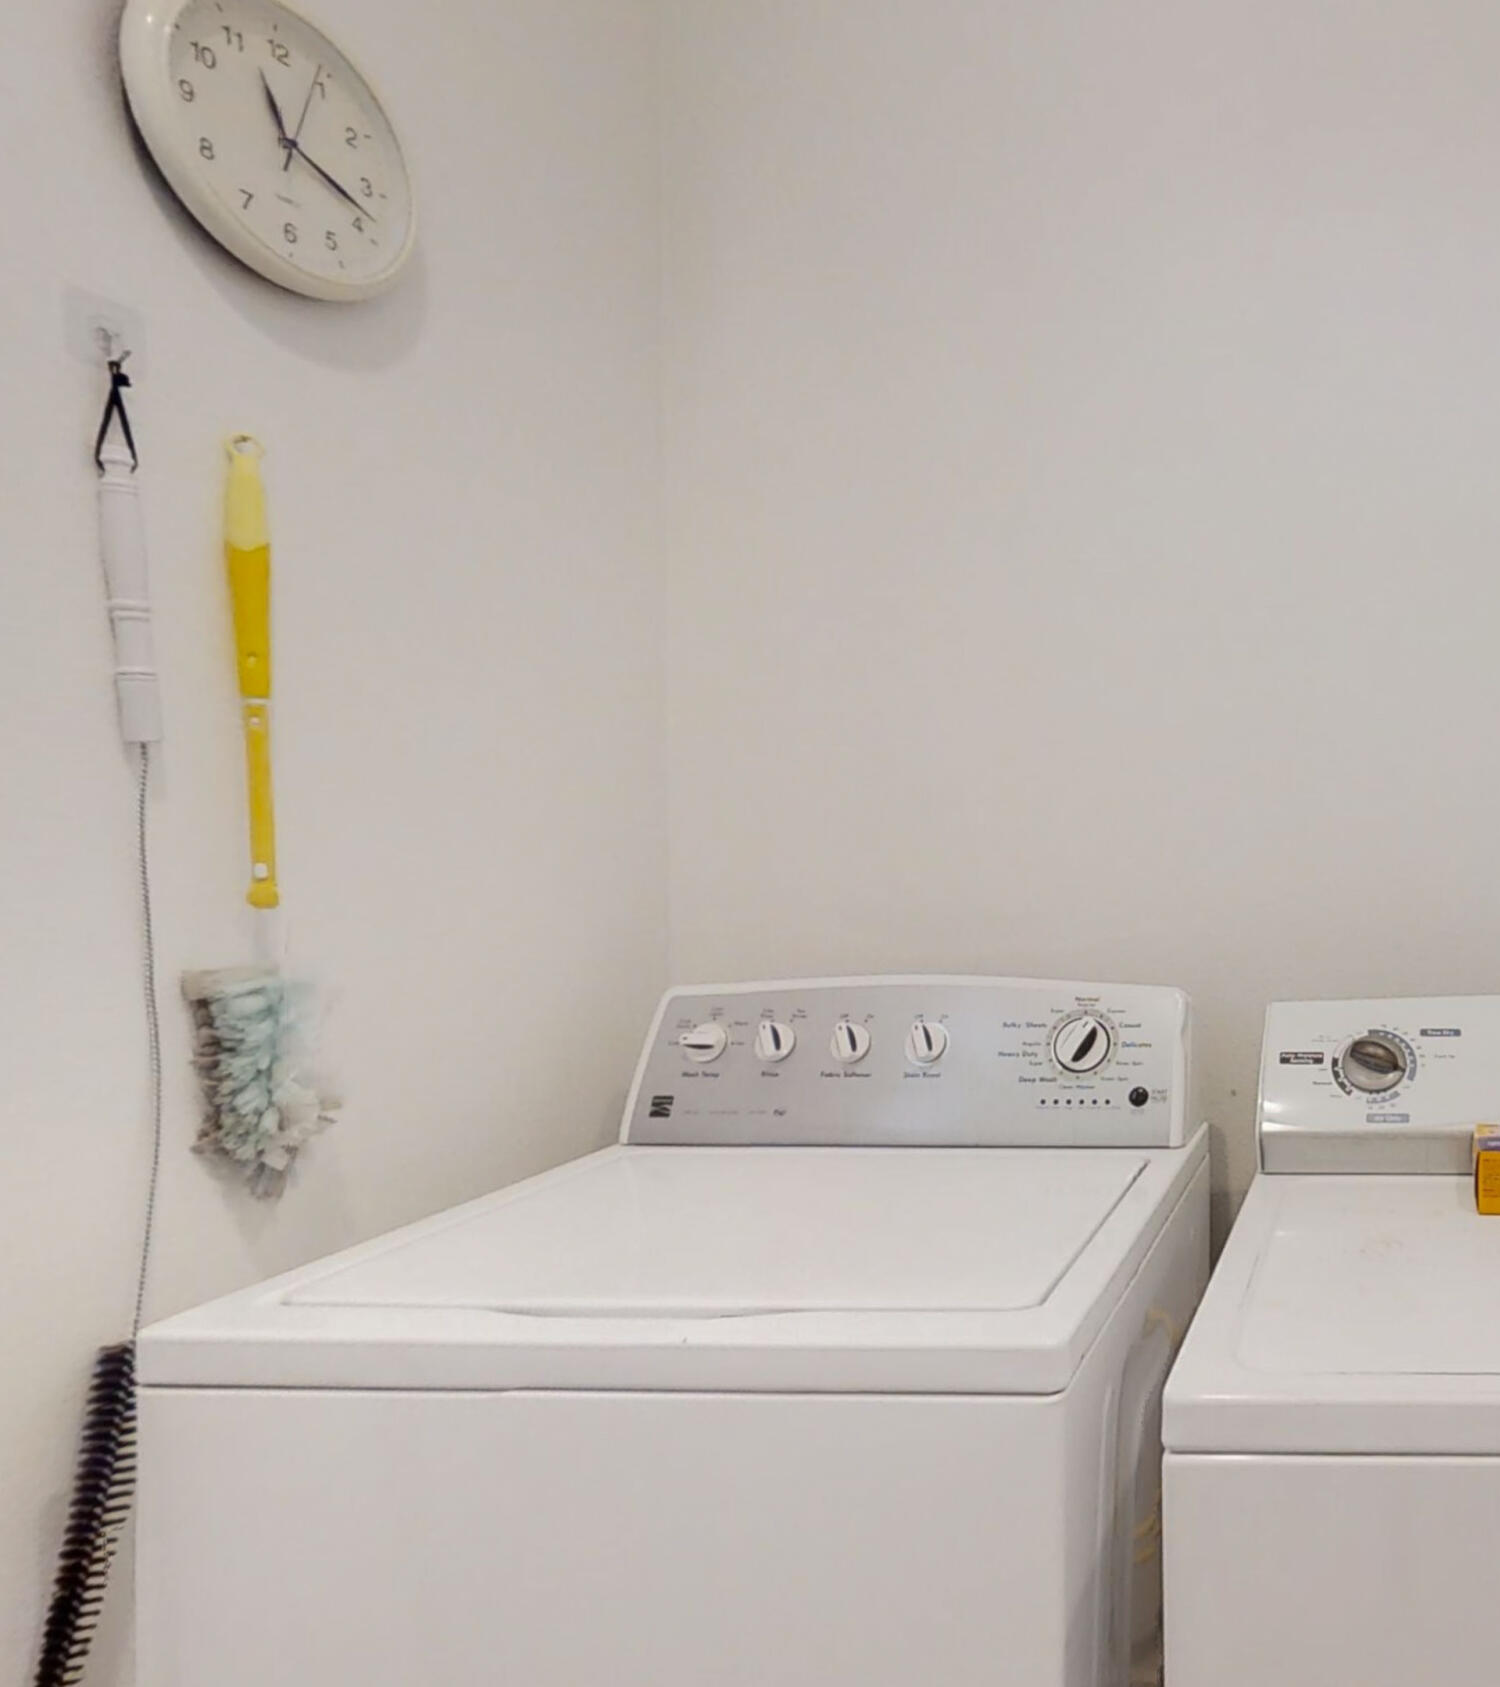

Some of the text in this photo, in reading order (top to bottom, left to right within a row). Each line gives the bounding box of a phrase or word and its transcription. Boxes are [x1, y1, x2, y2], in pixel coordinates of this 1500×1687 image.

[221, 24, 245, 52] 11
[189, 40, 218, 70] 10
[266, 38, 292, 67] 12
[178, 78, 196, 103] 9
[199, 136, 215, 161] 8
[344, 127, 359, 149] 2
[238, 187, 255, 211] 7
[360, 177, 374, 199] 3
[283, 222, 299, 244] 6
[351, 216, 365, 235] 4
[324, 230, 338, 252] 5
